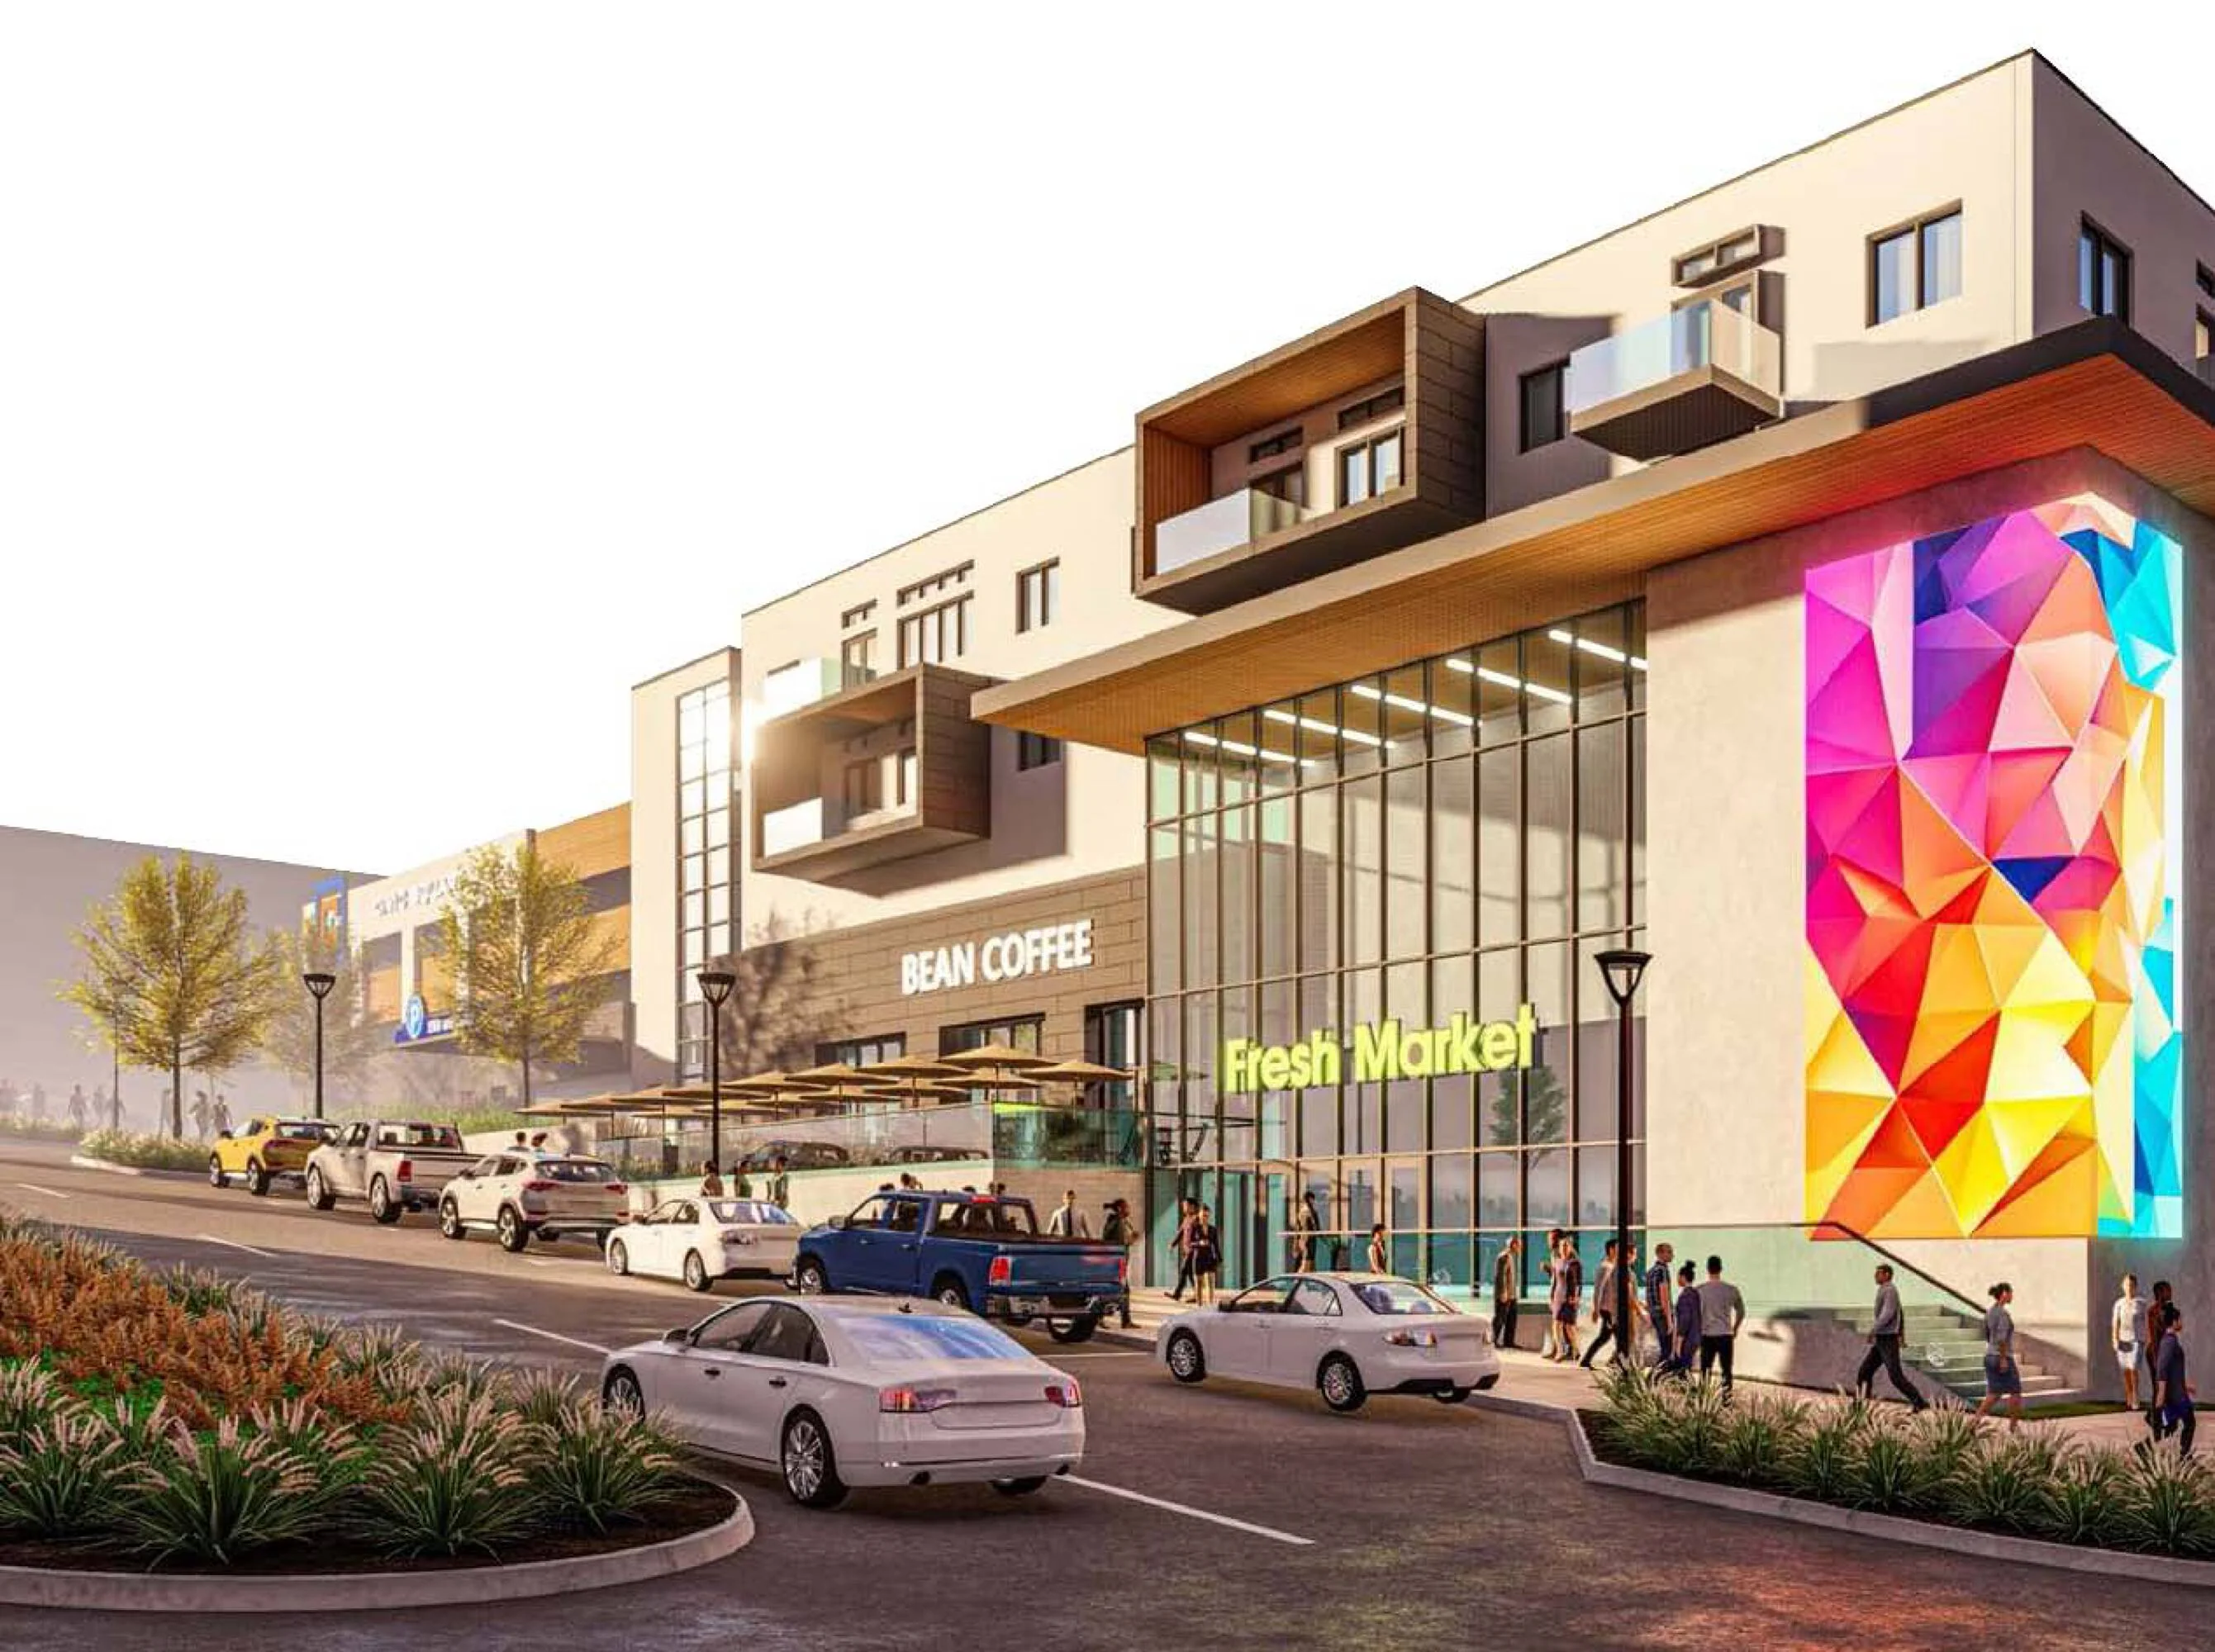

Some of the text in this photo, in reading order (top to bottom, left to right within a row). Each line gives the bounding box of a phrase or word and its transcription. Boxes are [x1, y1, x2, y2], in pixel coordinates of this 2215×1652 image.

[901, 919, 1094, 995] BEAN COFFEE
[1225, 1003, 1538, 1094] Fresh Market
